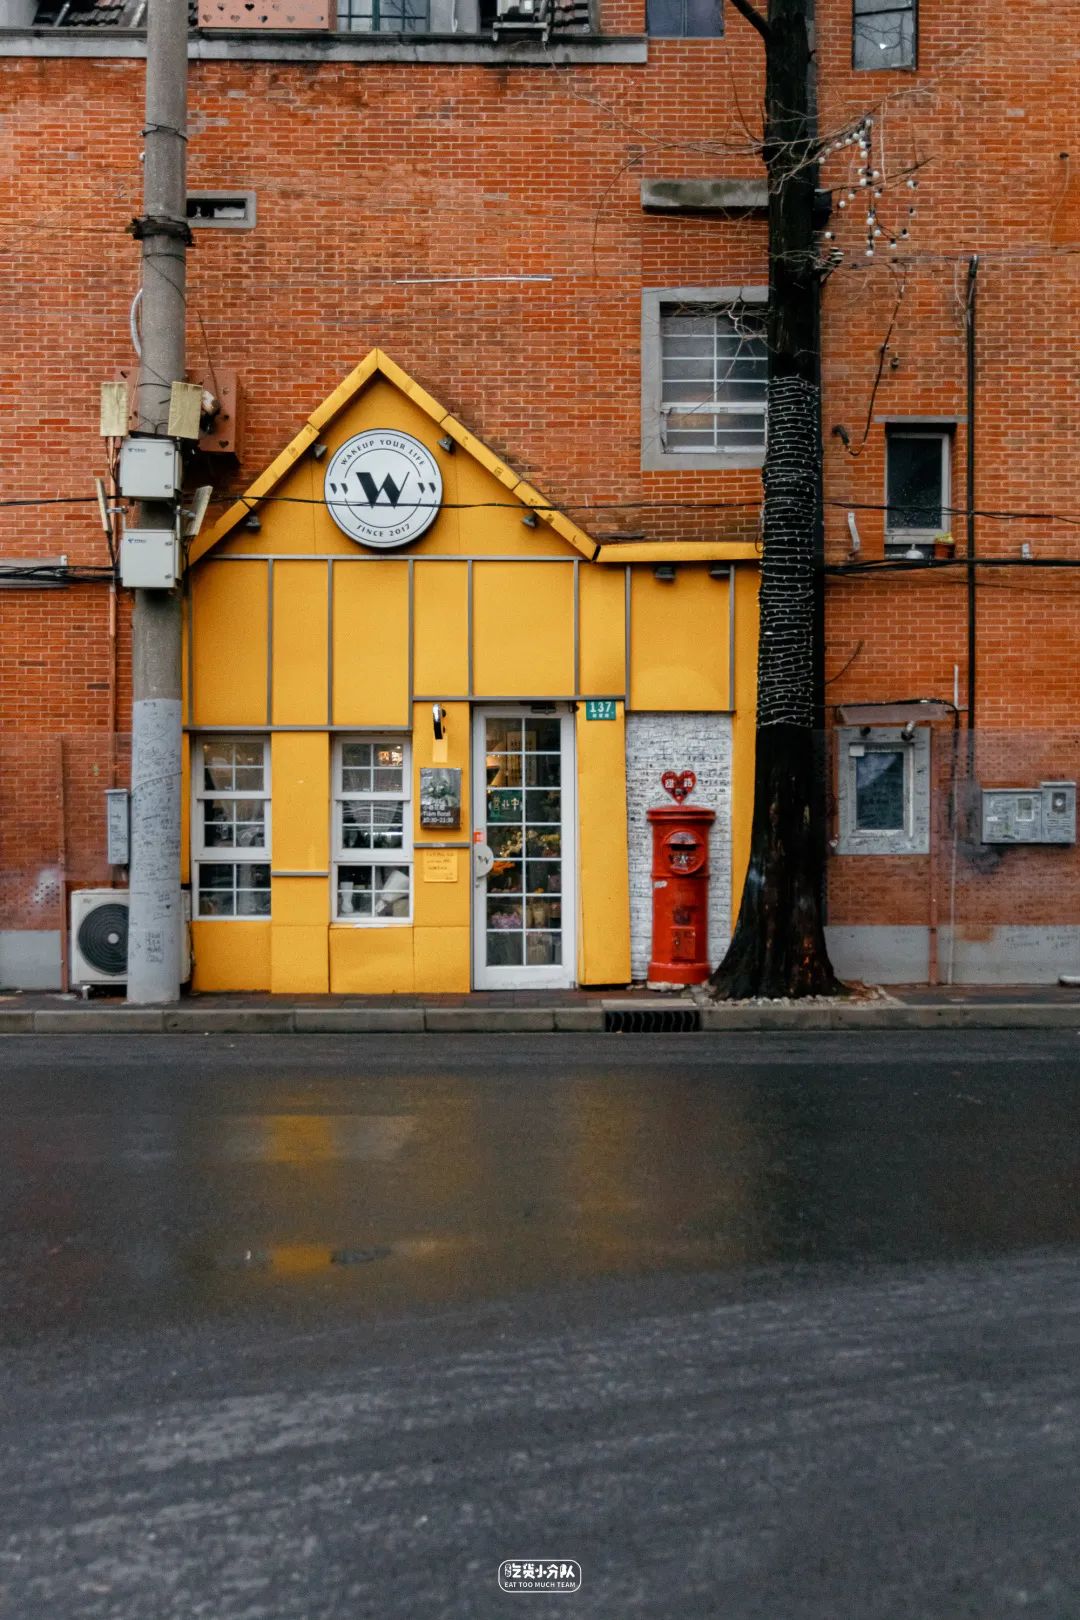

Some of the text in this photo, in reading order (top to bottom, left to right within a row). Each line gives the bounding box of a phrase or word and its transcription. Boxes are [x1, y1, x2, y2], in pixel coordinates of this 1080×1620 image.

[341, 439, 425, 466] WAKEUP YOUR LIFE
[355, 471, 410, 509] W
[356, 523, 411, 538] SINCE 2017
[590, 701, 612, 713] 137
